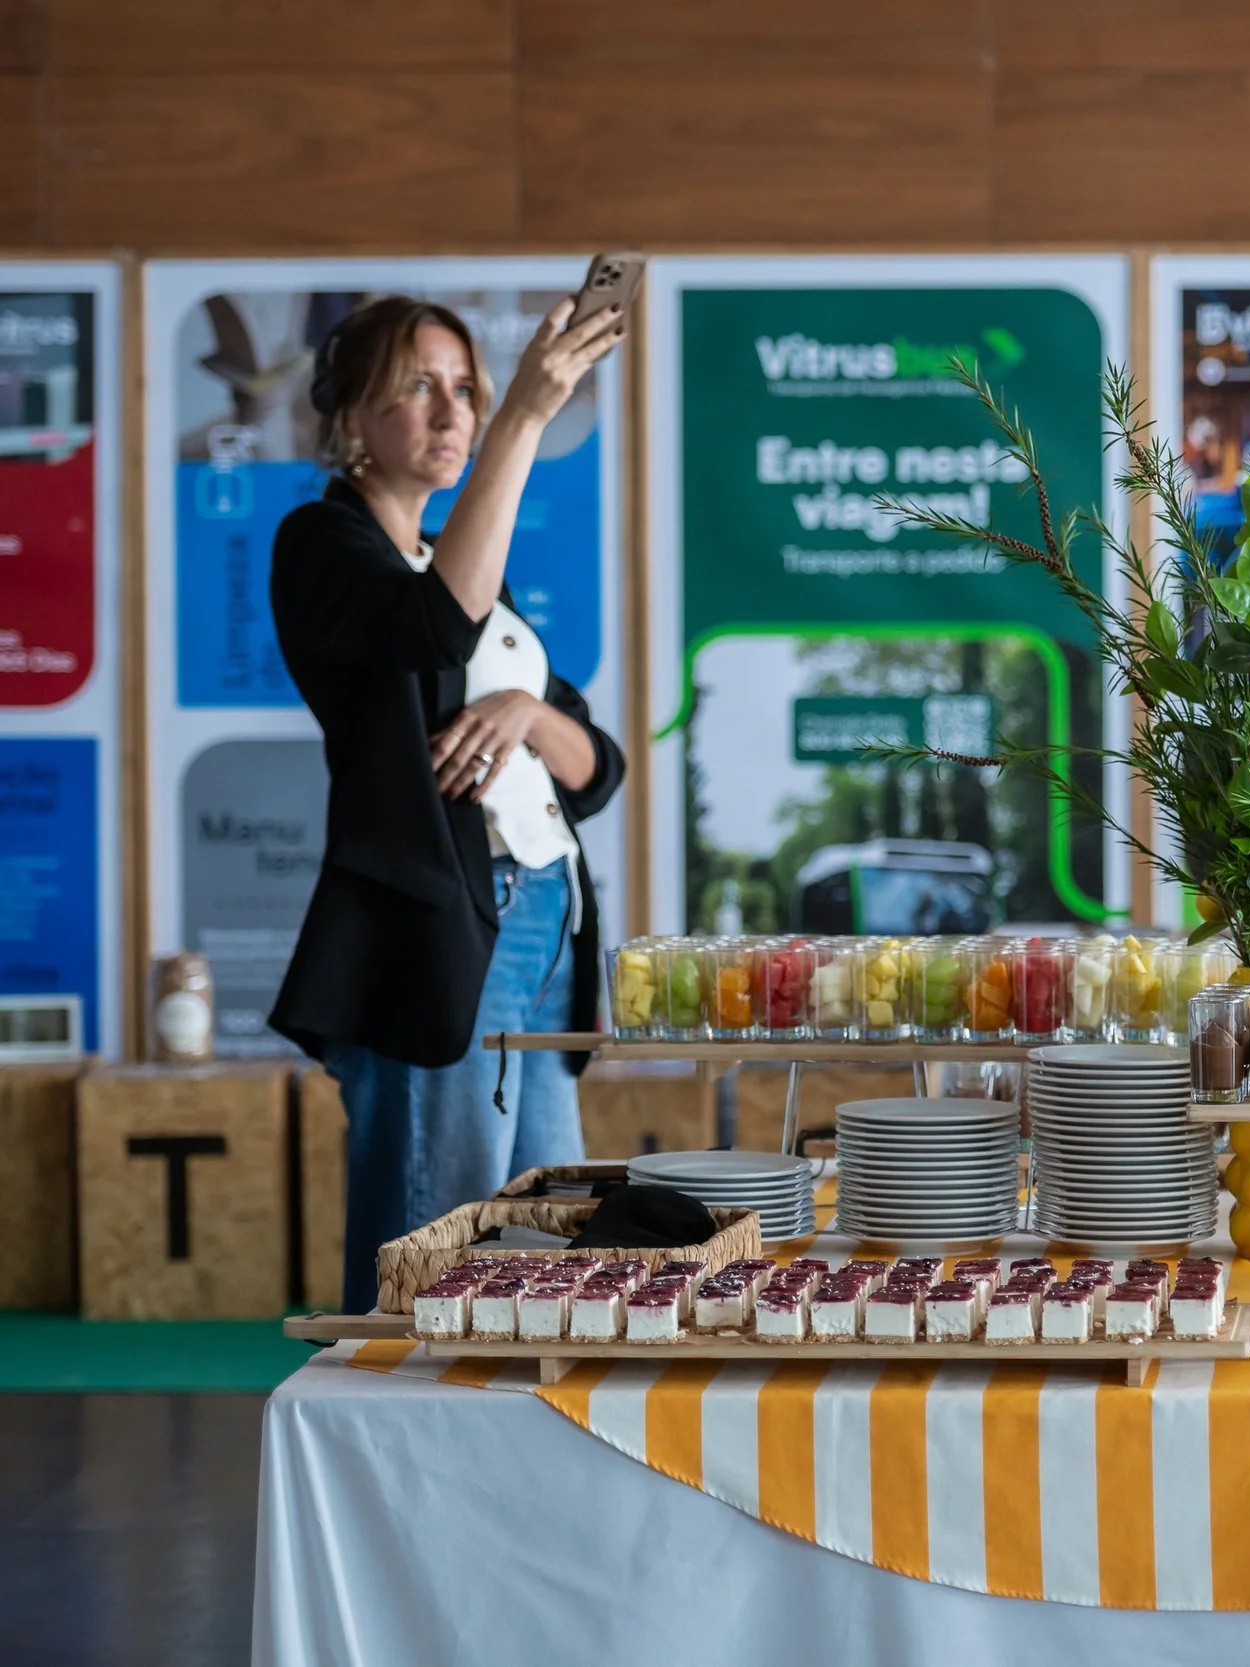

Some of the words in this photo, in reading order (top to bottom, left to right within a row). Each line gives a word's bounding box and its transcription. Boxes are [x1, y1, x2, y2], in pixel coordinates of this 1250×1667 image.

[756, 435, 889, 484] Entre
[895, 439, 1030, 484] nesta
[125, 1134, 229, 1262] T
